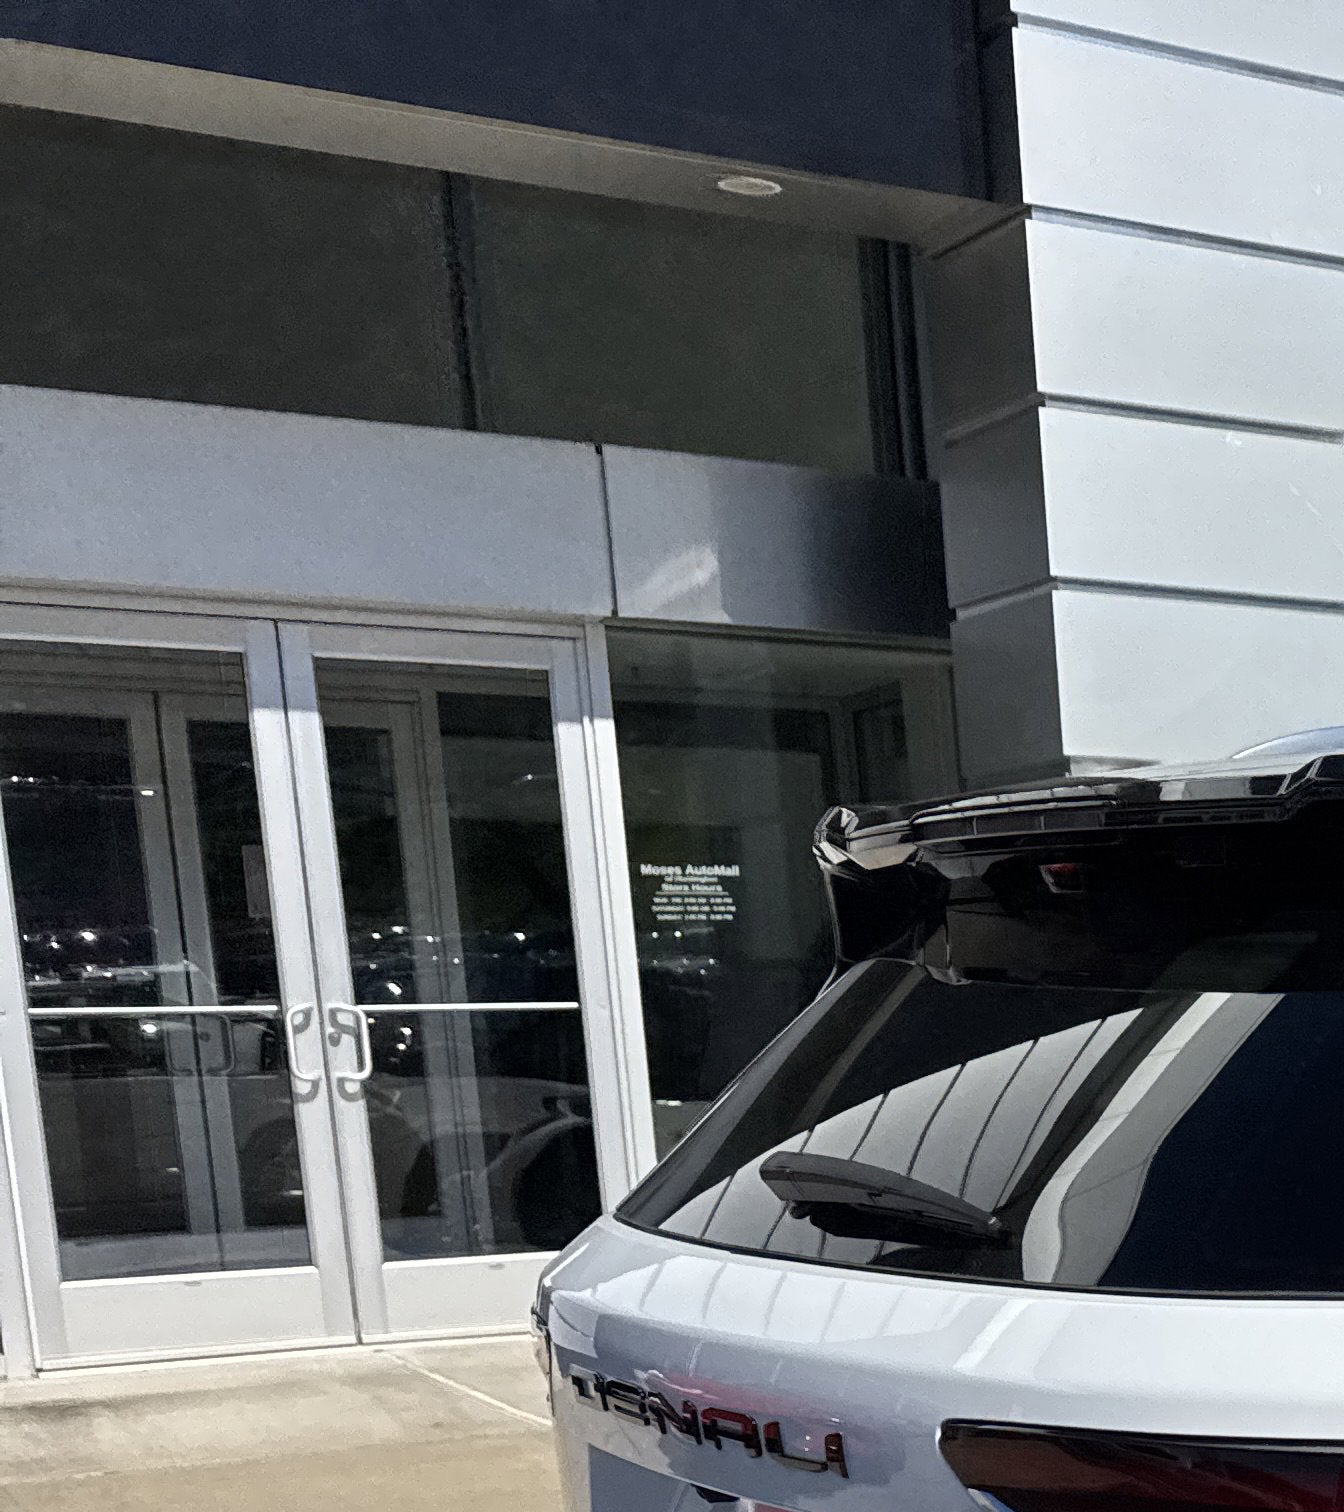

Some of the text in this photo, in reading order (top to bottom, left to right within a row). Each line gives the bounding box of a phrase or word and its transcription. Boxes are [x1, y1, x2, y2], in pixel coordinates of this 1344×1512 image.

[640, 864, 740, 877] Moses AutoMall
[570, 1364, 849, 1479] DENALI
